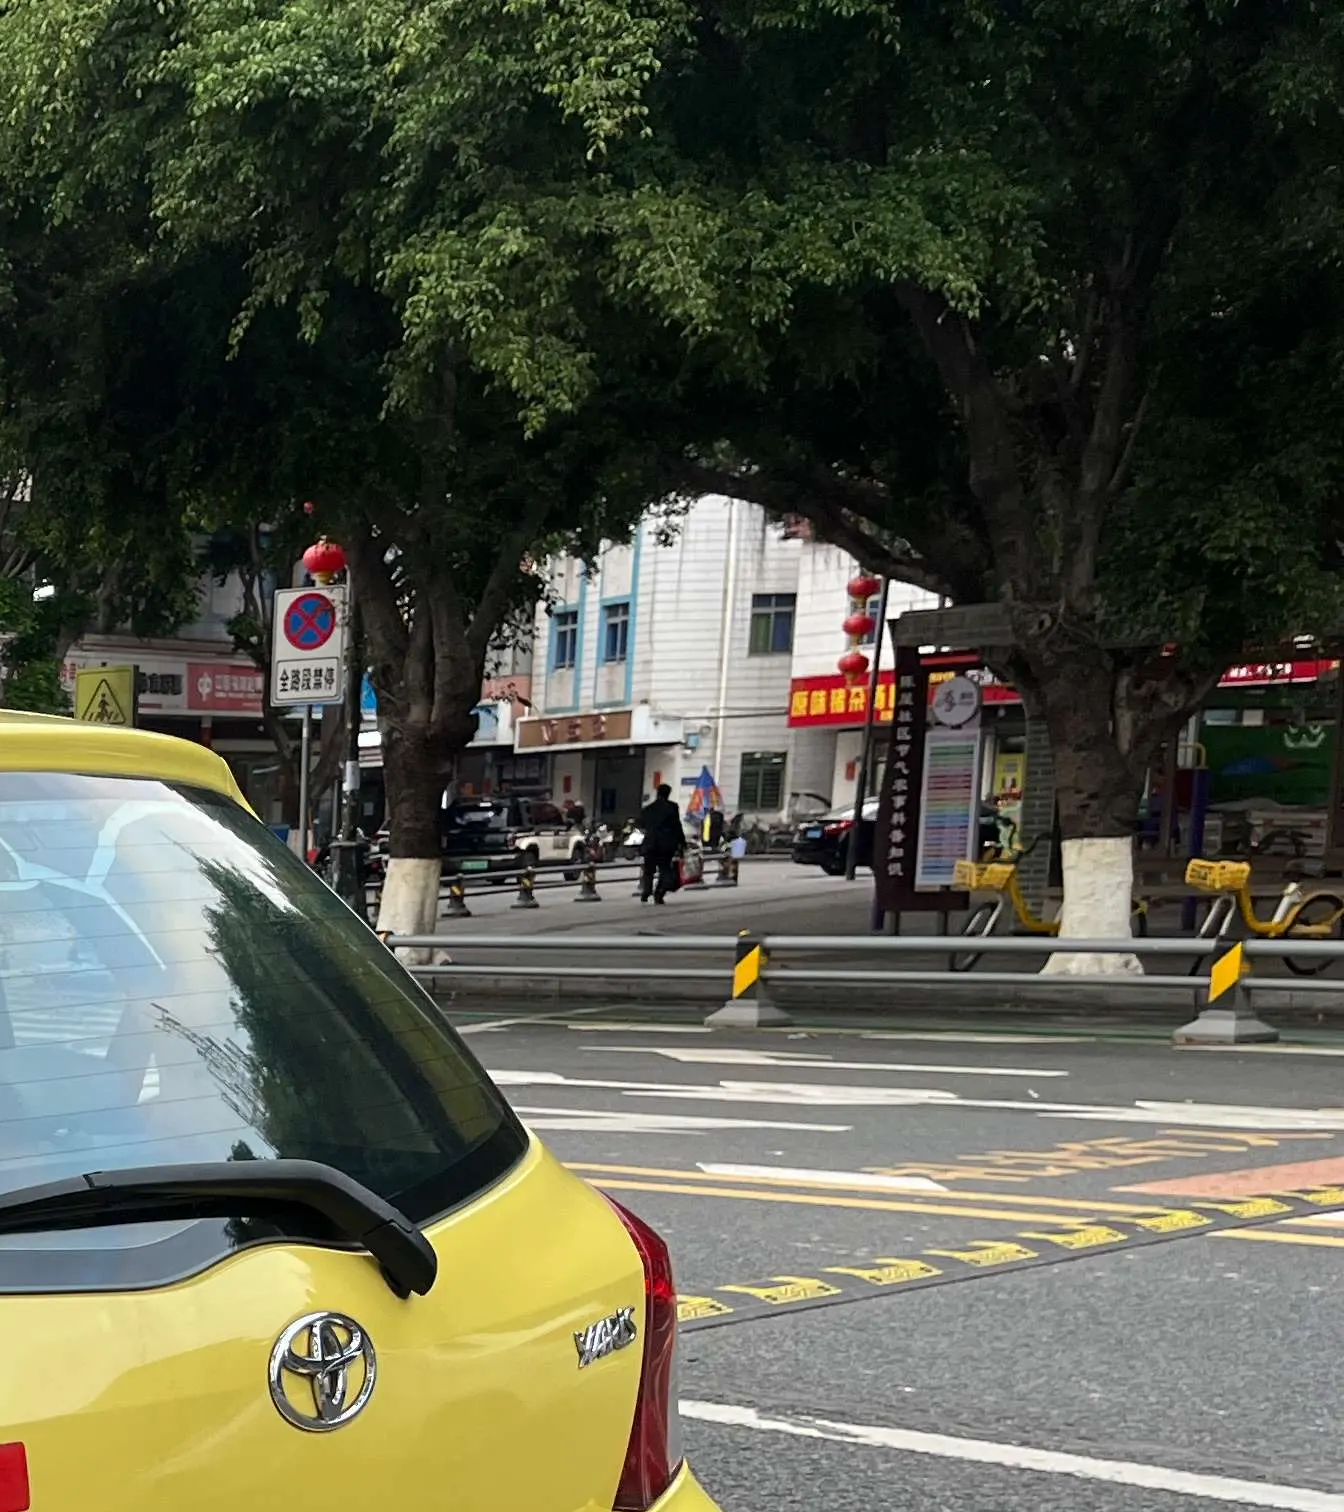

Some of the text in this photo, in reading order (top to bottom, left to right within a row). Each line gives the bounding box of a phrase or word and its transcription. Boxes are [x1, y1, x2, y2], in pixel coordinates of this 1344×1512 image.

[279, 667, 334, 692] 全路段禁停
